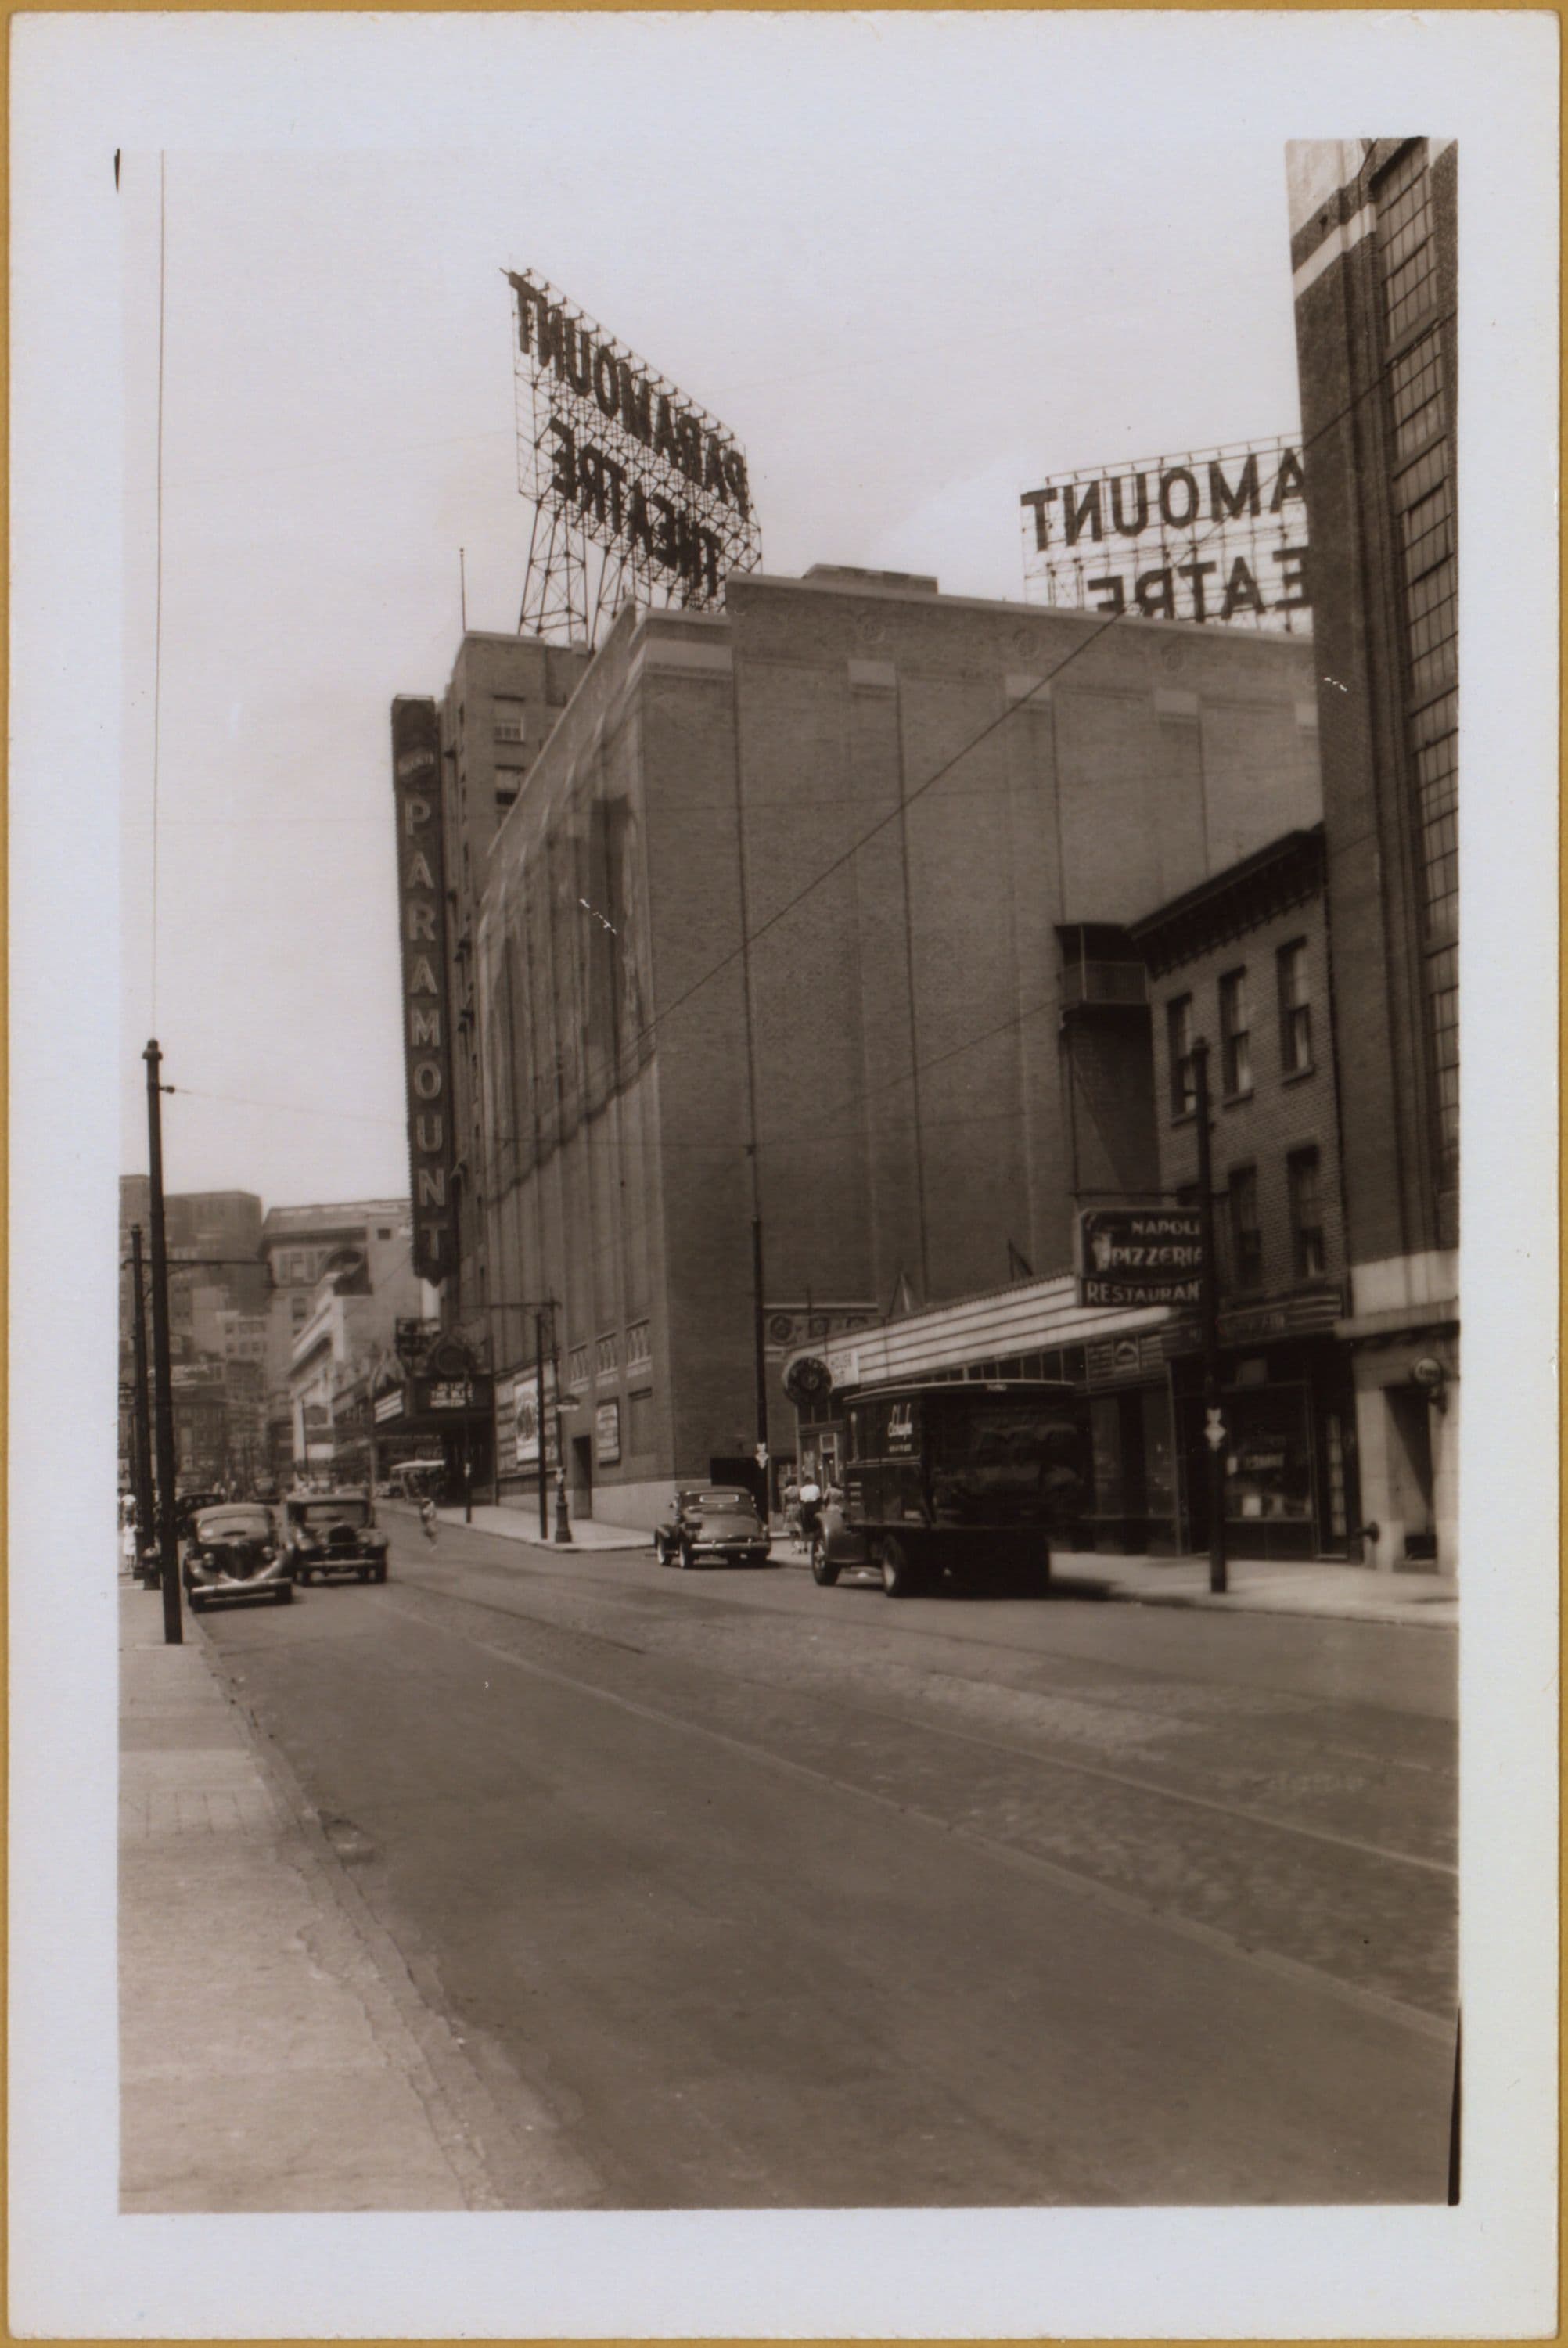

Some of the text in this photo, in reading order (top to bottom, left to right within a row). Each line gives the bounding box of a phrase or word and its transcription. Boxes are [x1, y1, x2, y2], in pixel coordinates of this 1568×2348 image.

[404, 799, 448, 1260] PARAMOUNT
[1131, 1220, 1201, 1235] NAPOLI
[1086, 1280, 1203, 1303] RESTAURAN
